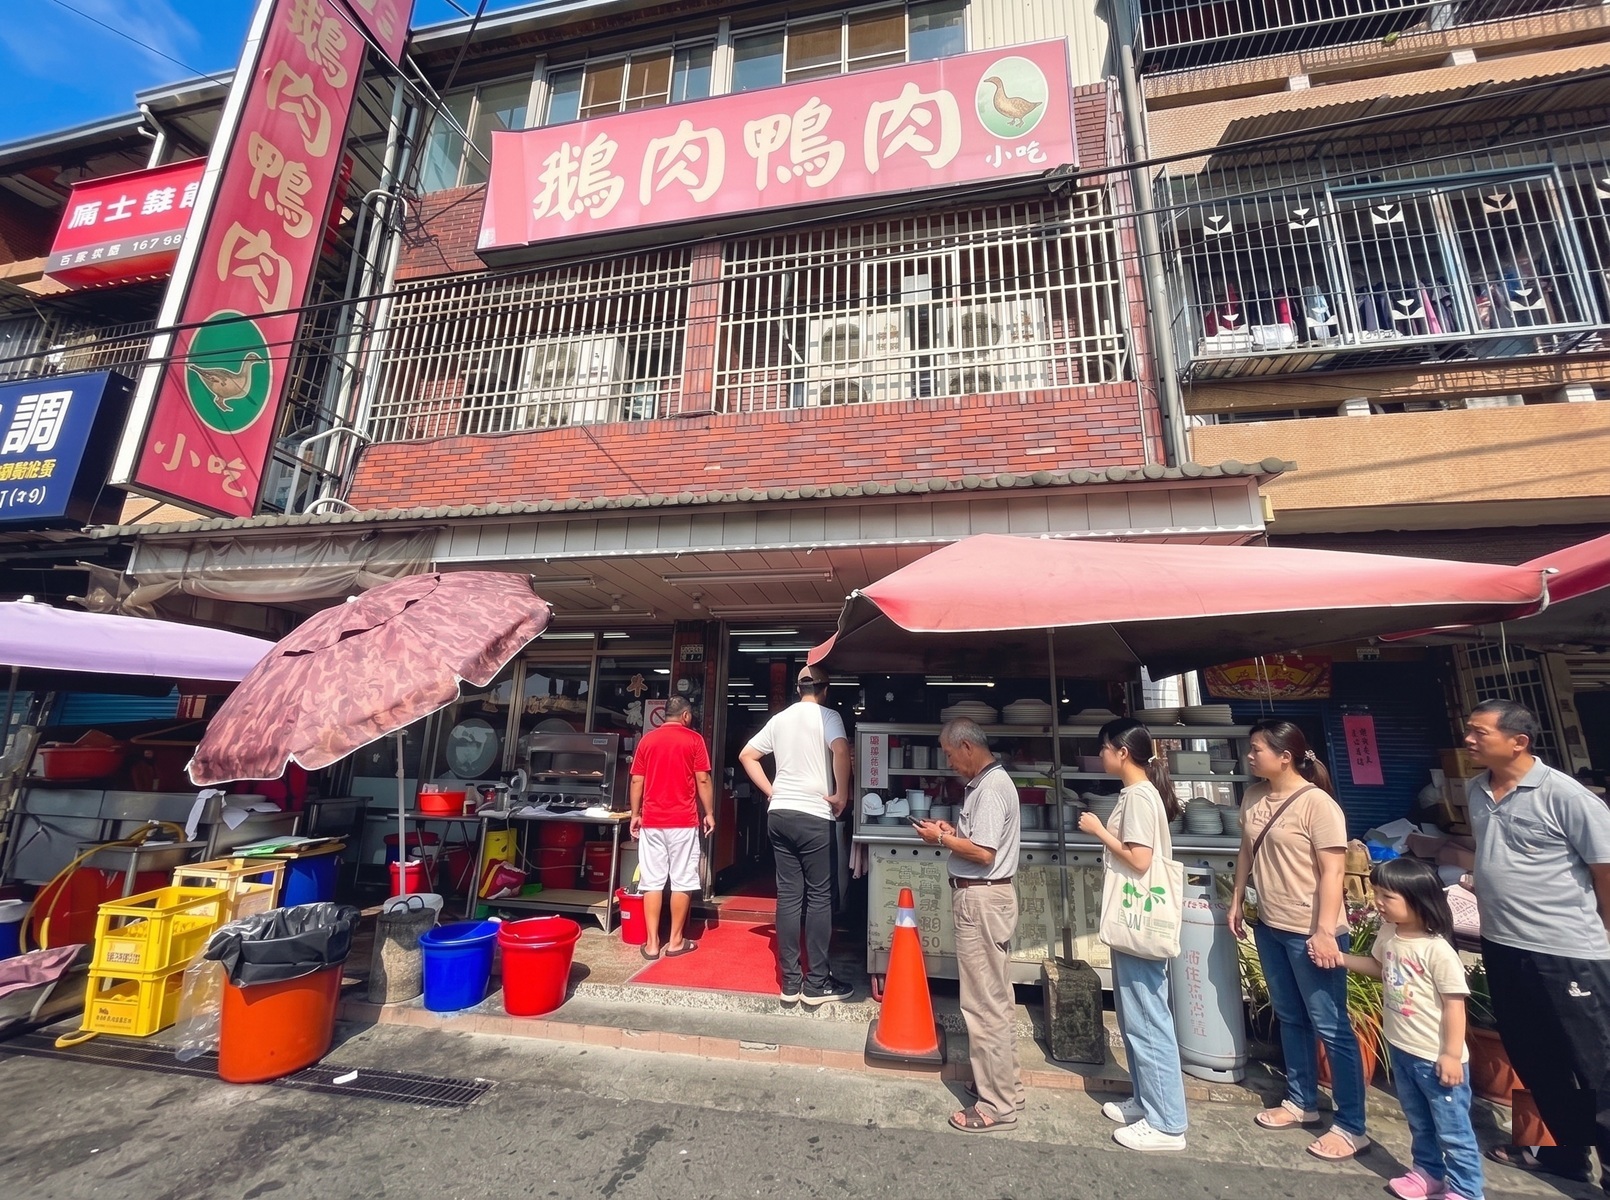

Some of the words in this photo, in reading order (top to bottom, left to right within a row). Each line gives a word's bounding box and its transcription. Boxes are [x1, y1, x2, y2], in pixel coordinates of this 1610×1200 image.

[218, 0, 349, 318] 鵝肉鴨肉
[532, 82, 962, 222] 鵝肉鴨肉
[984, 140, 1048, 169] 小吃
[132, 237, 160, 251] 167
[154, 433, 248, 498] 小吃
